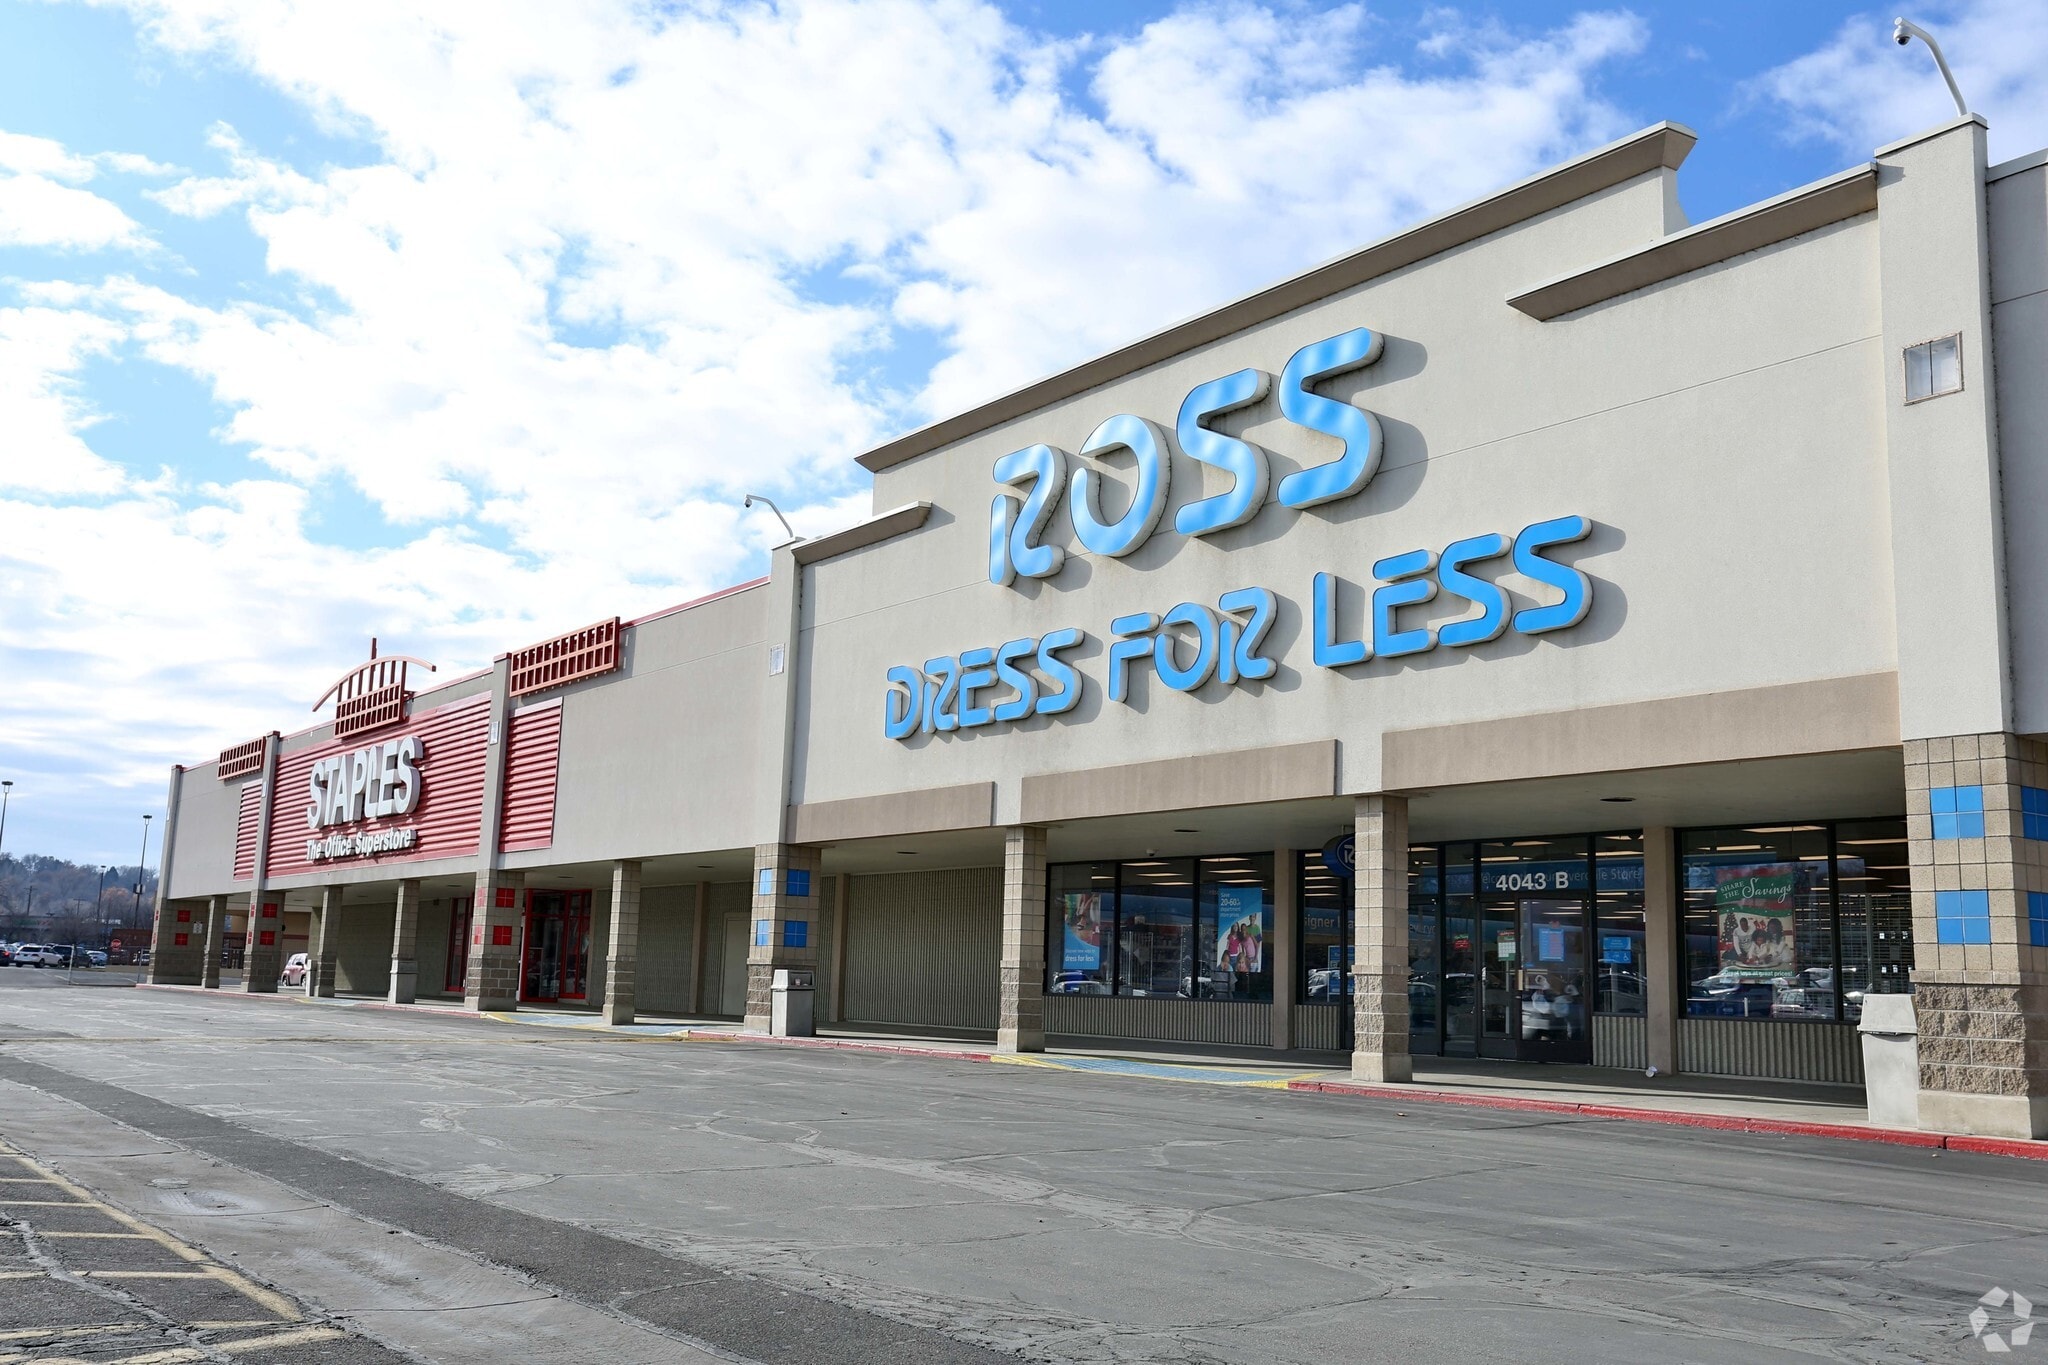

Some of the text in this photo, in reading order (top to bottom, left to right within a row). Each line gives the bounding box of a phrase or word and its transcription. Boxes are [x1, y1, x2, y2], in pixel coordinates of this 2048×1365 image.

[988, 326, 1385, 586] ROSS
[884, 514, 1594, 741] DRESS FOR LESS
[306, 735, 423, 830] STAPLES
[306, 827, 417, 861] The Office Superstore
[1496, 871, 1569, 891] 4043 B
[1721, 881, 1745, 893] SHARE
[1723, 877, 1792, 904] THE Savings
